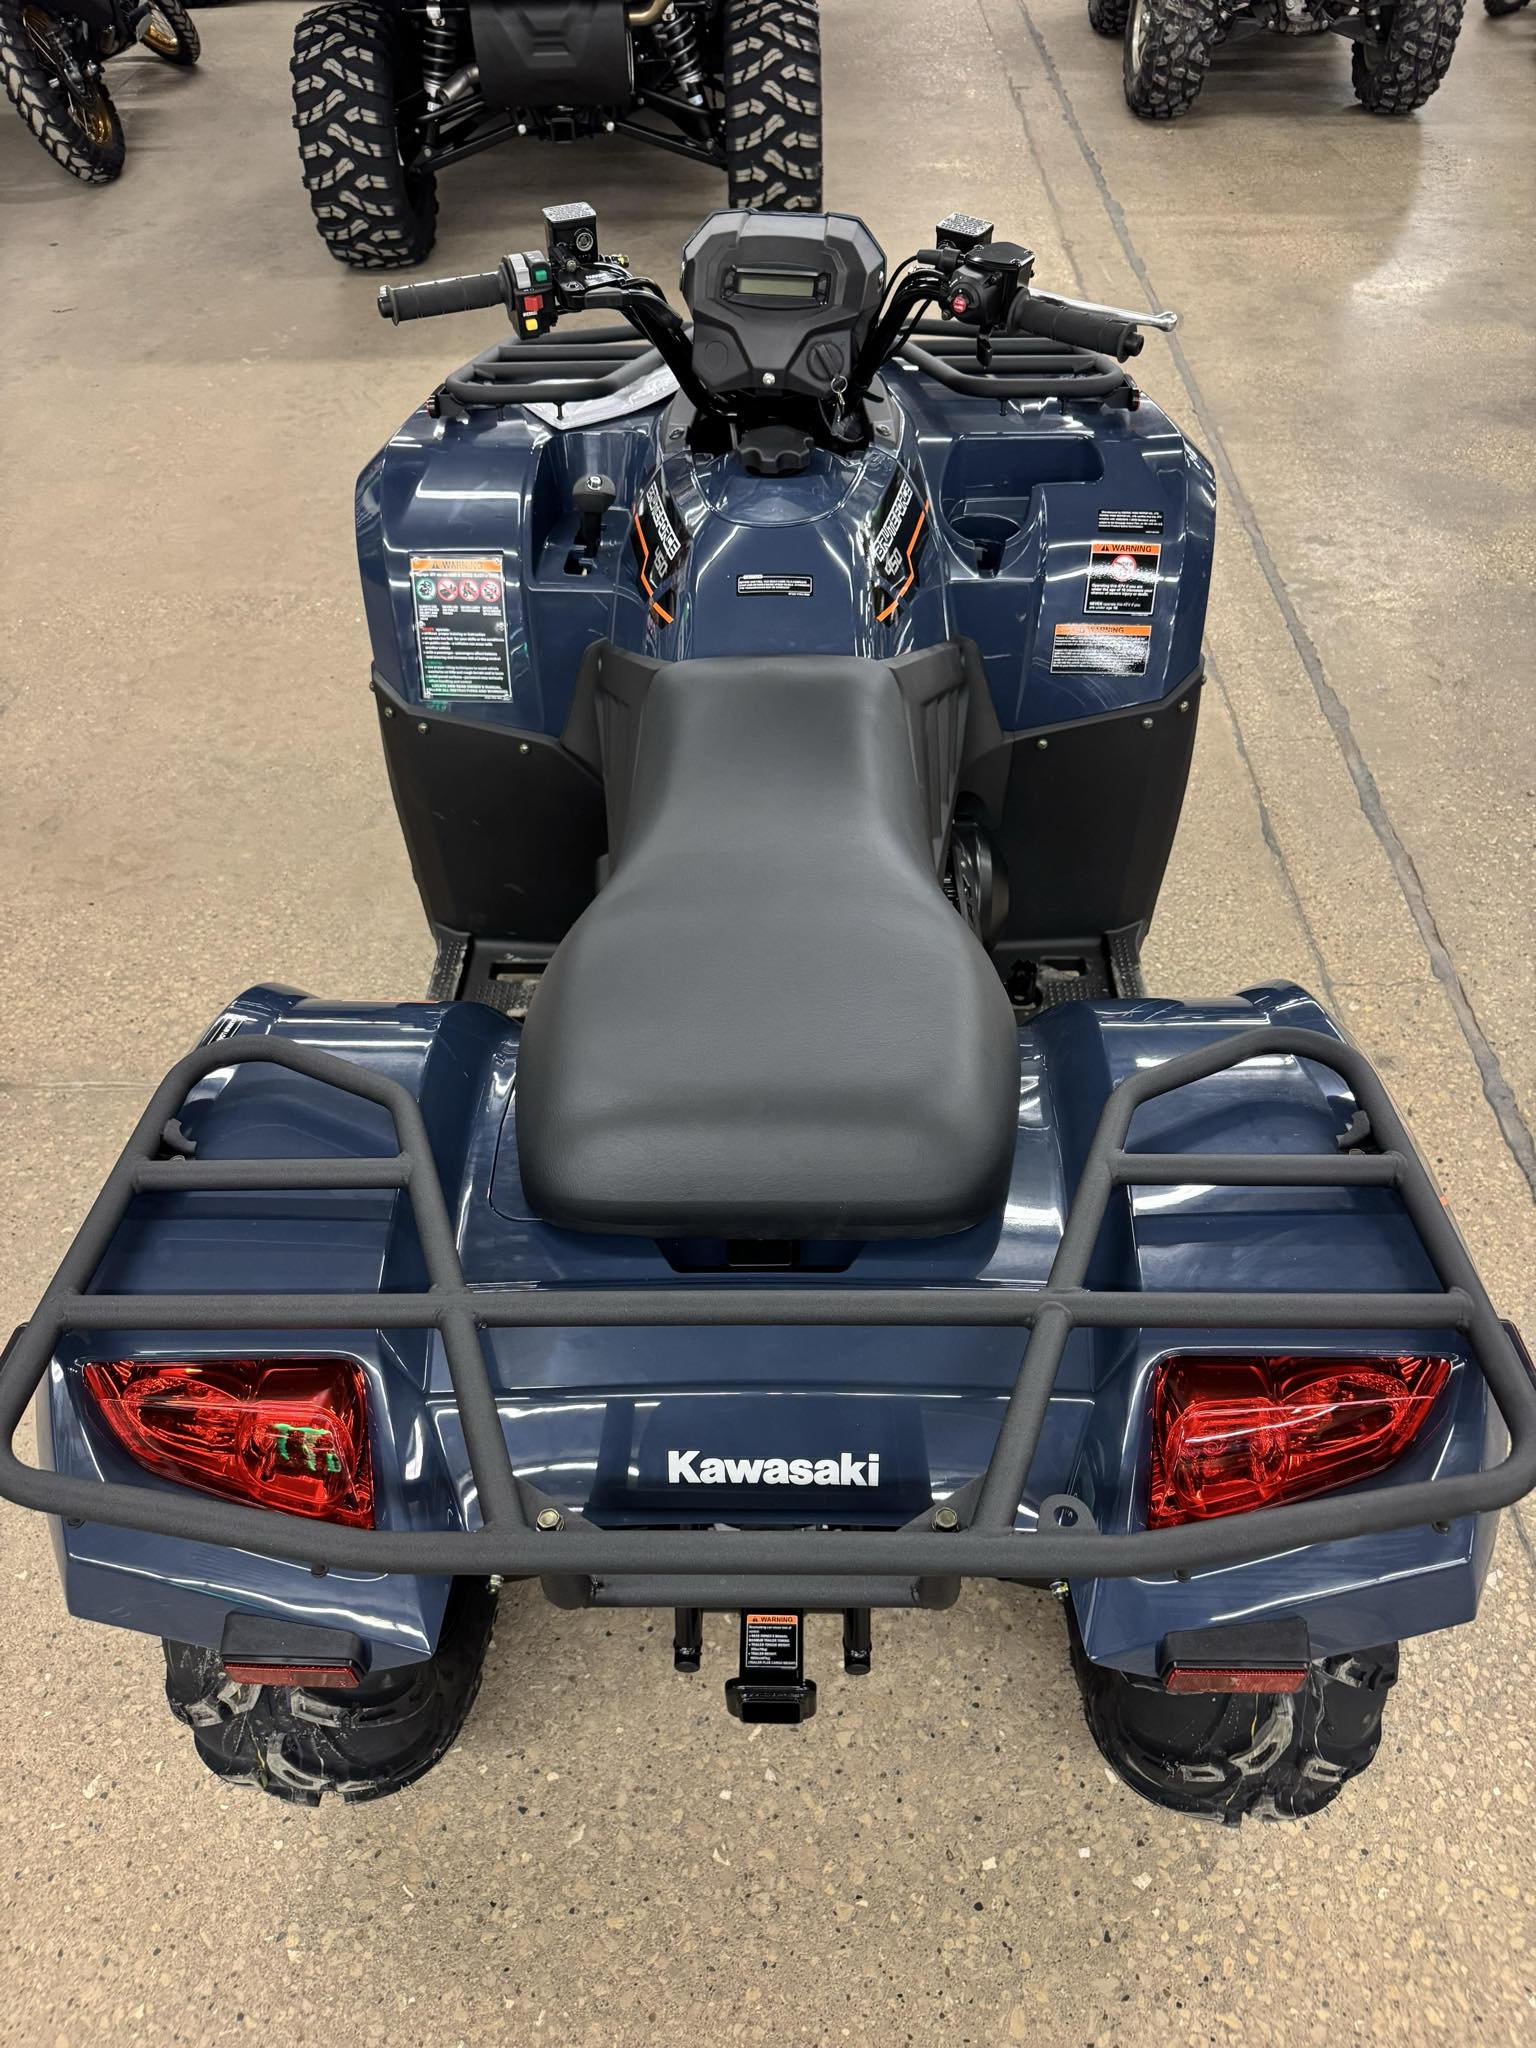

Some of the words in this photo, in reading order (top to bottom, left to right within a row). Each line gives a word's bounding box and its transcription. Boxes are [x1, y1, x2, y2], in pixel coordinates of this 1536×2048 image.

[1111, 544, 1152, 553] WARNING
[440, 560, 484, 570] WARNING
[884, 546, 903, 576] 450
[668, 1450, 880, 1486] Kawasaki
